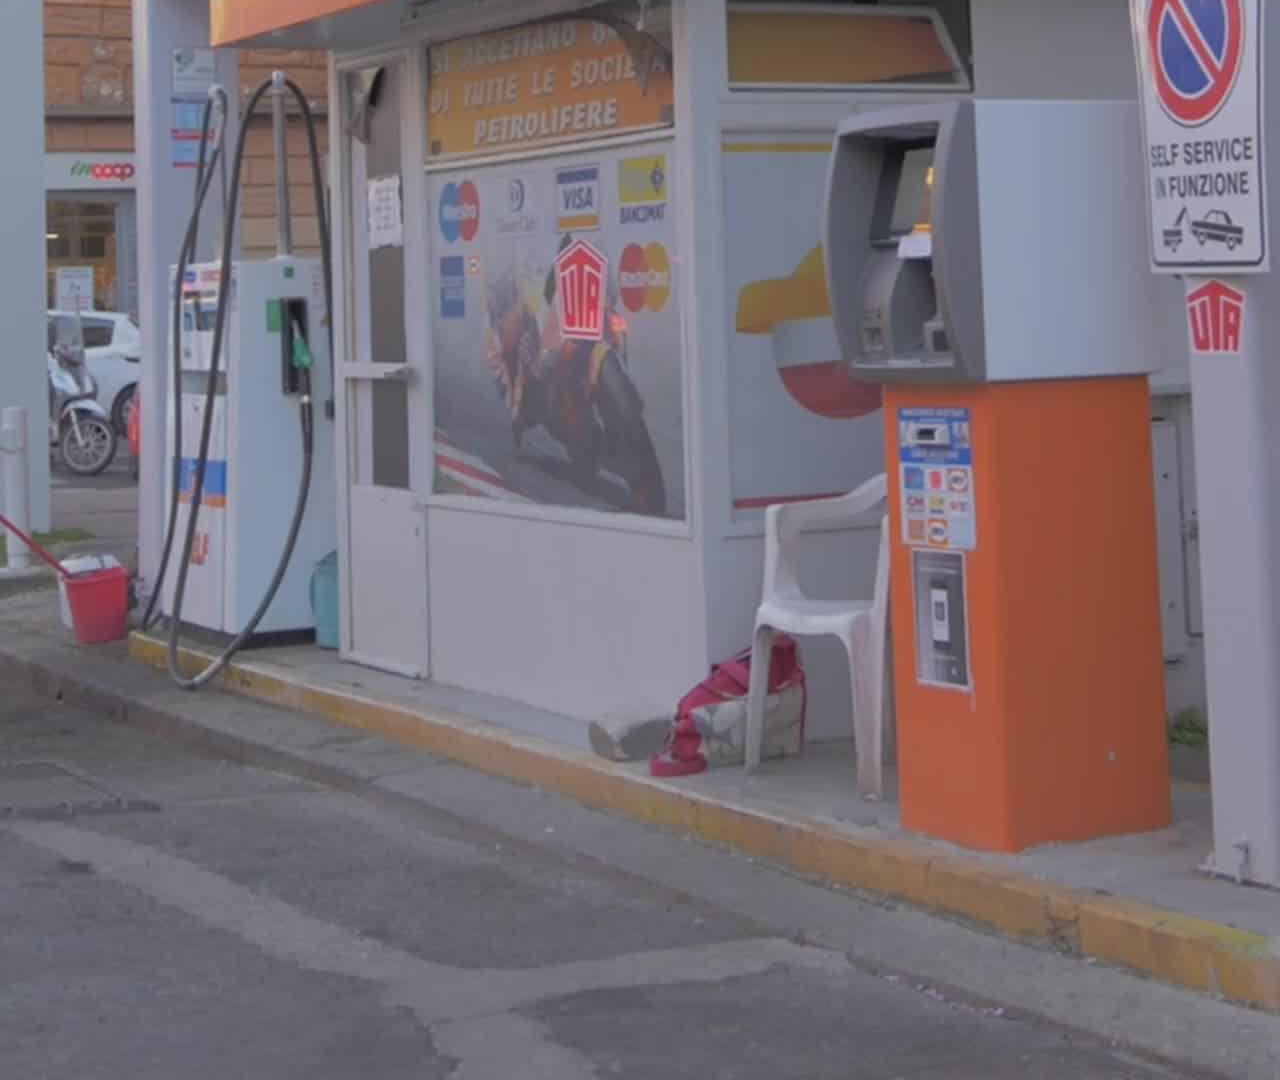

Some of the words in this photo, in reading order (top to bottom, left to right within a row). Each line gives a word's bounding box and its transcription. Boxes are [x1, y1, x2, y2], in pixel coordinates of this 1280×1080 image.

[431, 88, 450, 114] DI
[464, 73, 520, 108] TUTTE
[532, 69, 556, 95] LE
[571, 53, 666, 90] SOCIEA
[474, 98, 617, 146] PETROLIFERE
[1151, 144, 1179, 168] SELF
[1183, 137, 1253, 165] SERVICE
[563, 186, 593, 210] VISA
[1155, 177, 1167, 199] IN
[1168, 171, 1249, 198] FUNZIONE
[1187, 280, 1244, 352] UTA
